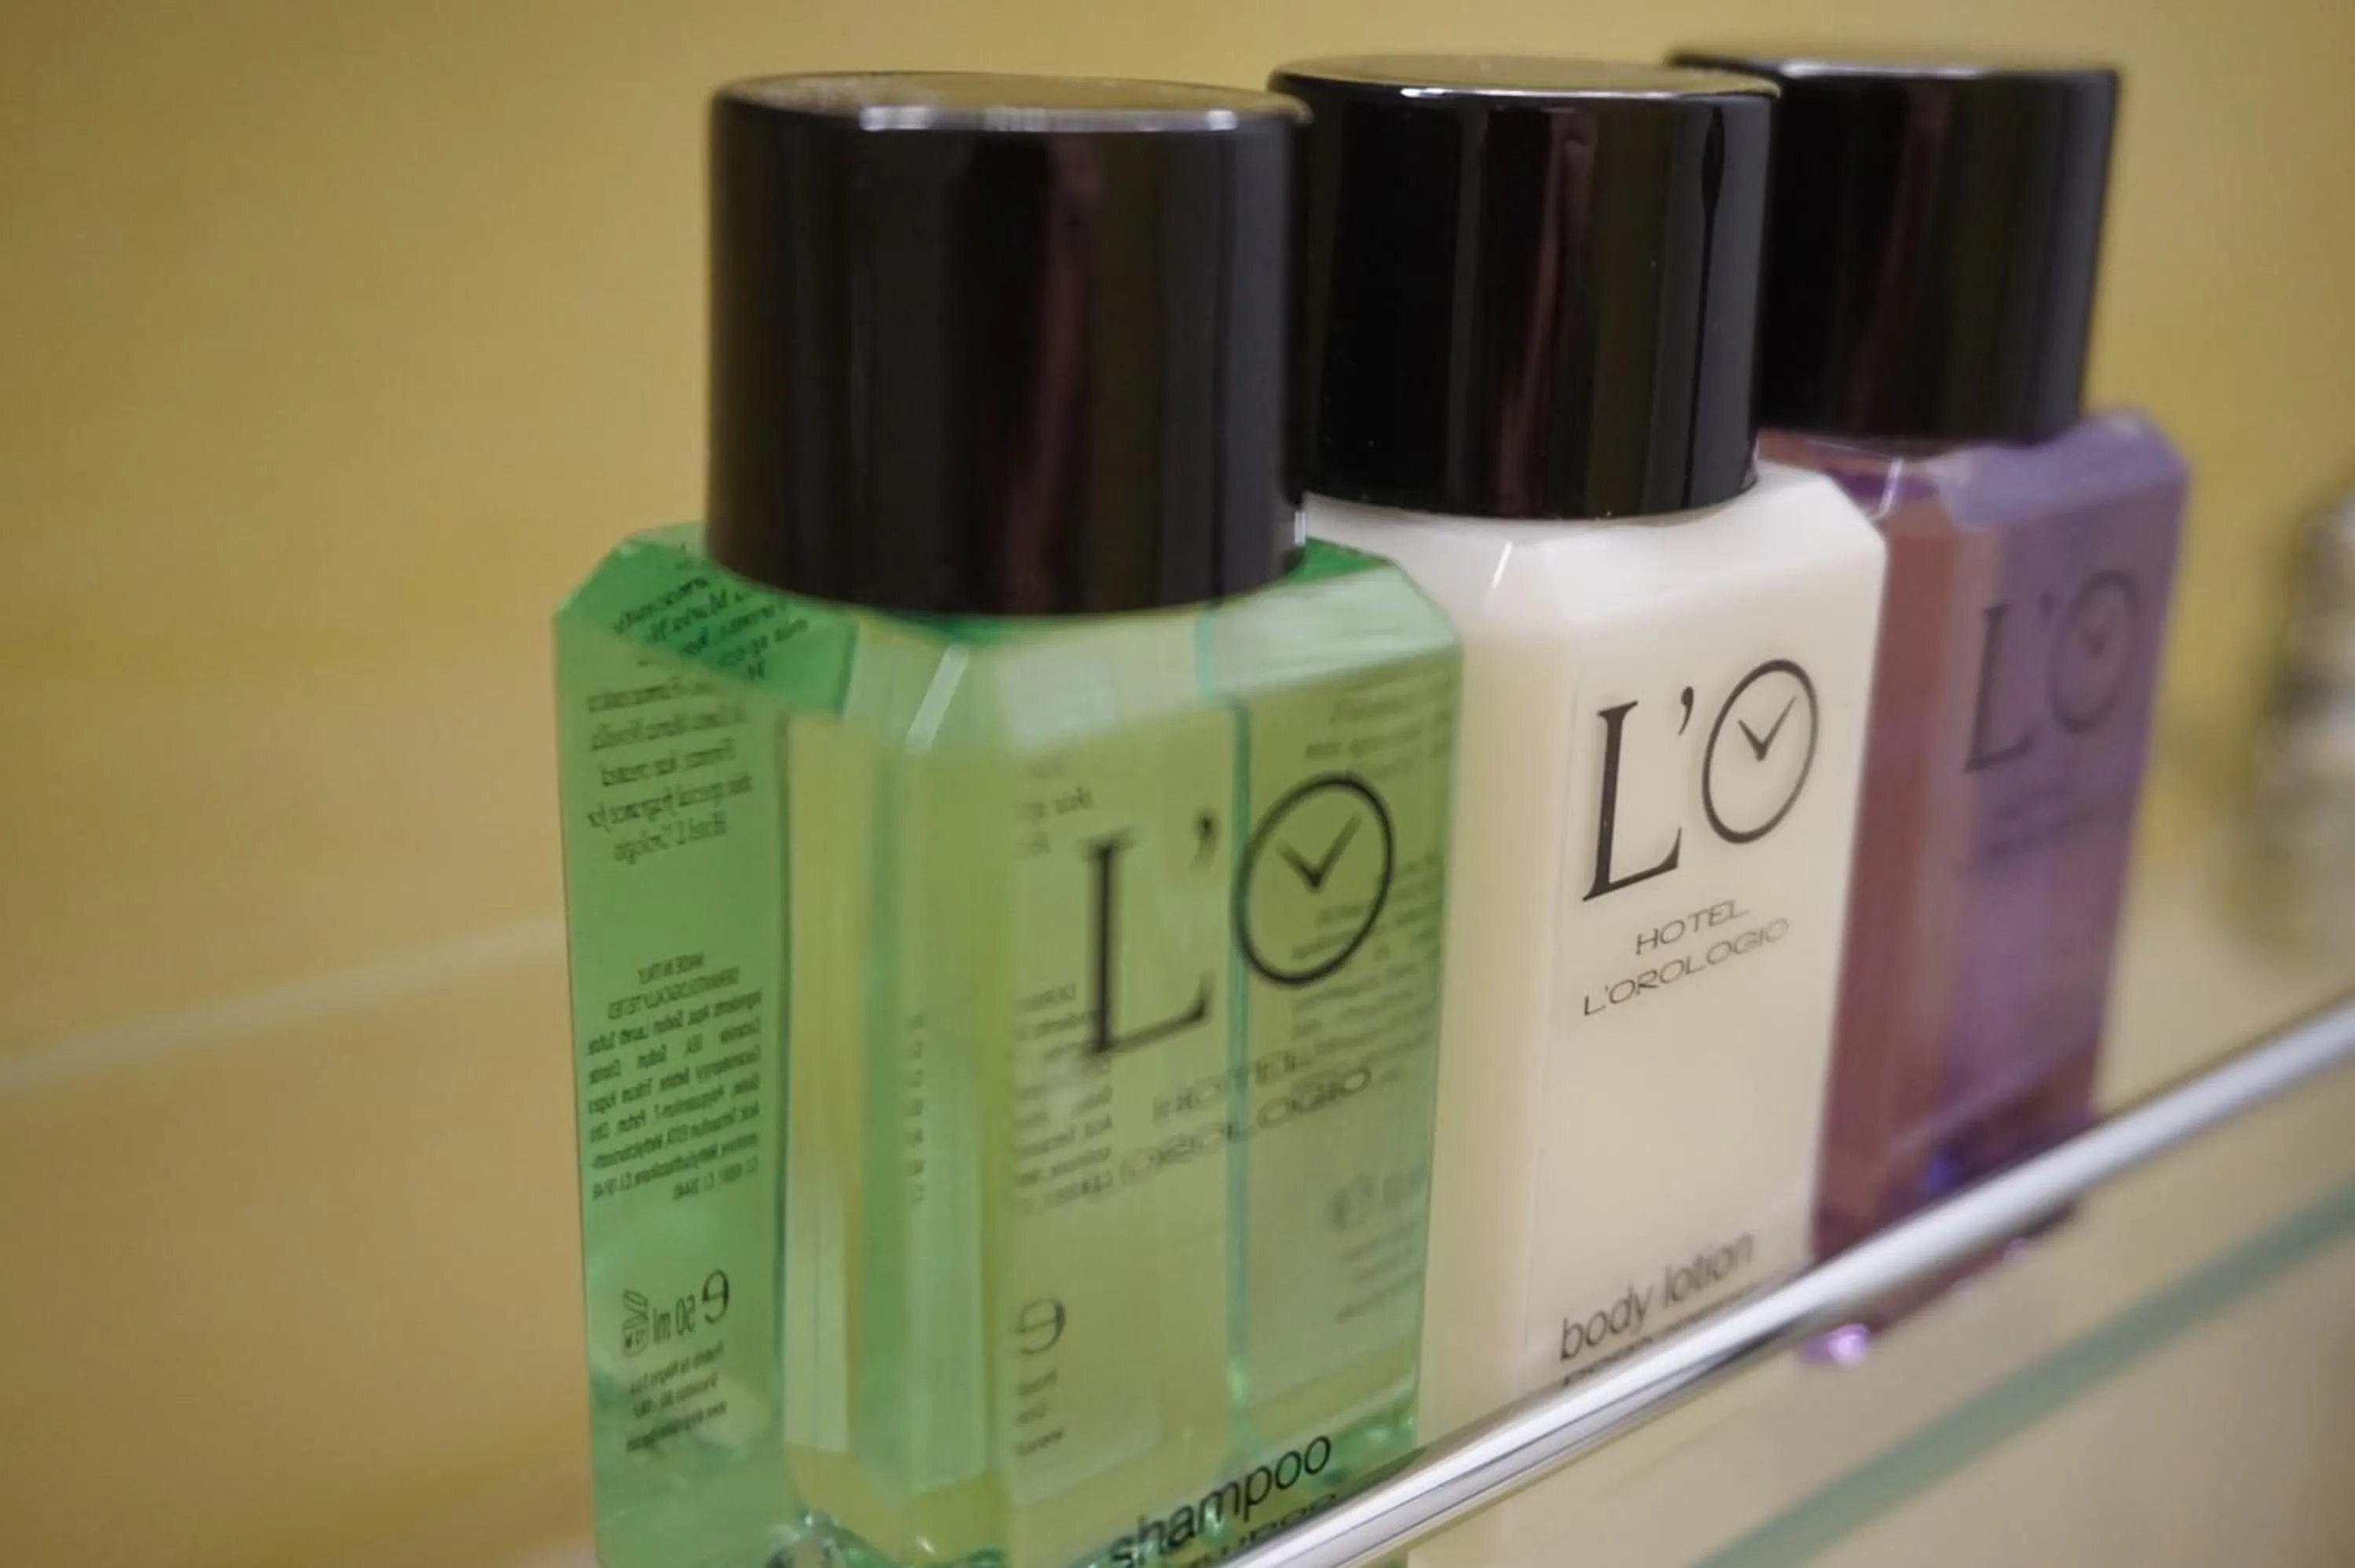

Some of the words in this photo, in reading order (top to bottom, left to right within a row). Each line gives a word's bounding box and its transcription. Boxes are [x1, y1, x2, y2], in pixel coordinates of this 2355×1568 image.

[1582, 658, 1819, 903] L'O
[1583, 917, 1790, 1017] L'OROLOGIO
[1635, 899, 1751, 956] HOTEL
[1559, 1284, 1653, 1362] body
[1109, 1435, 1332, 1568] shampoo
